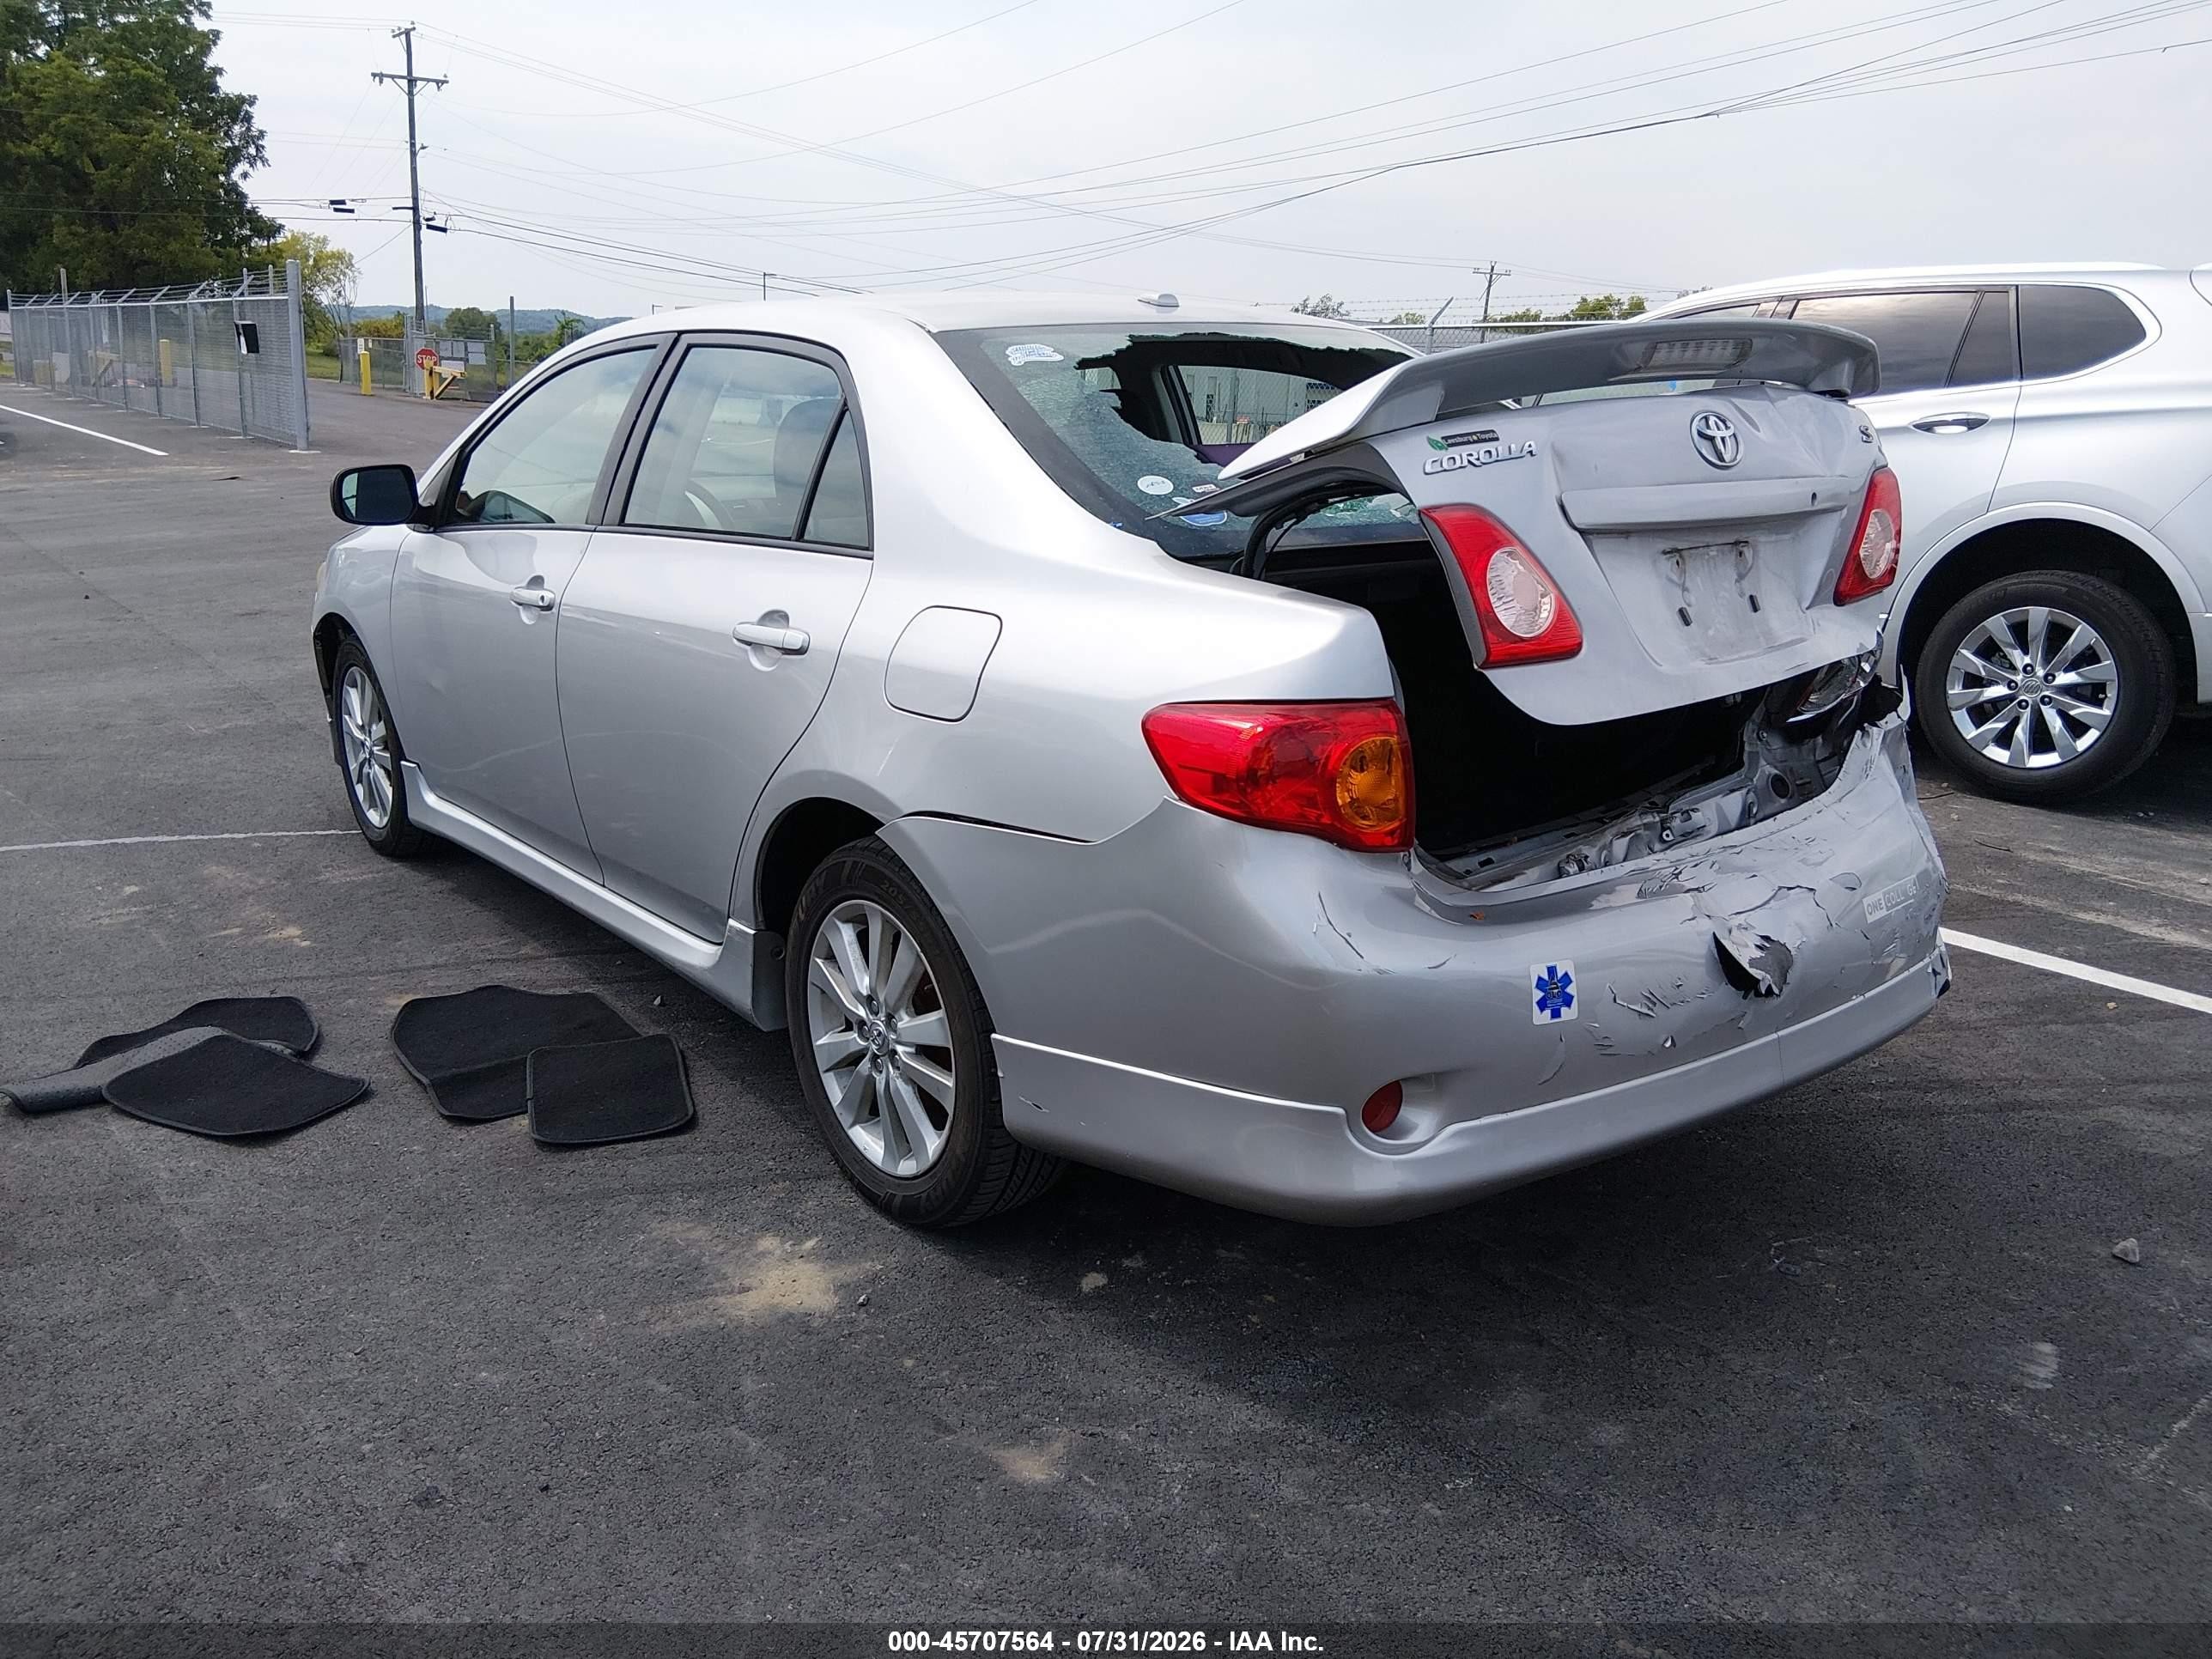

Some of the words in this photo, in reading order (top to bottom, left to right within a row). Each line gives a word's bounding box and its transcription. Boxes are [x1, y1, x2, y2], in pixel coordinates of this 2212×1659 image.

[1476, 432, 1498, 441] Toyota
[1423, 440, 1538, 475] COROLLA
[1866, 897, 1884, 915] ONE
